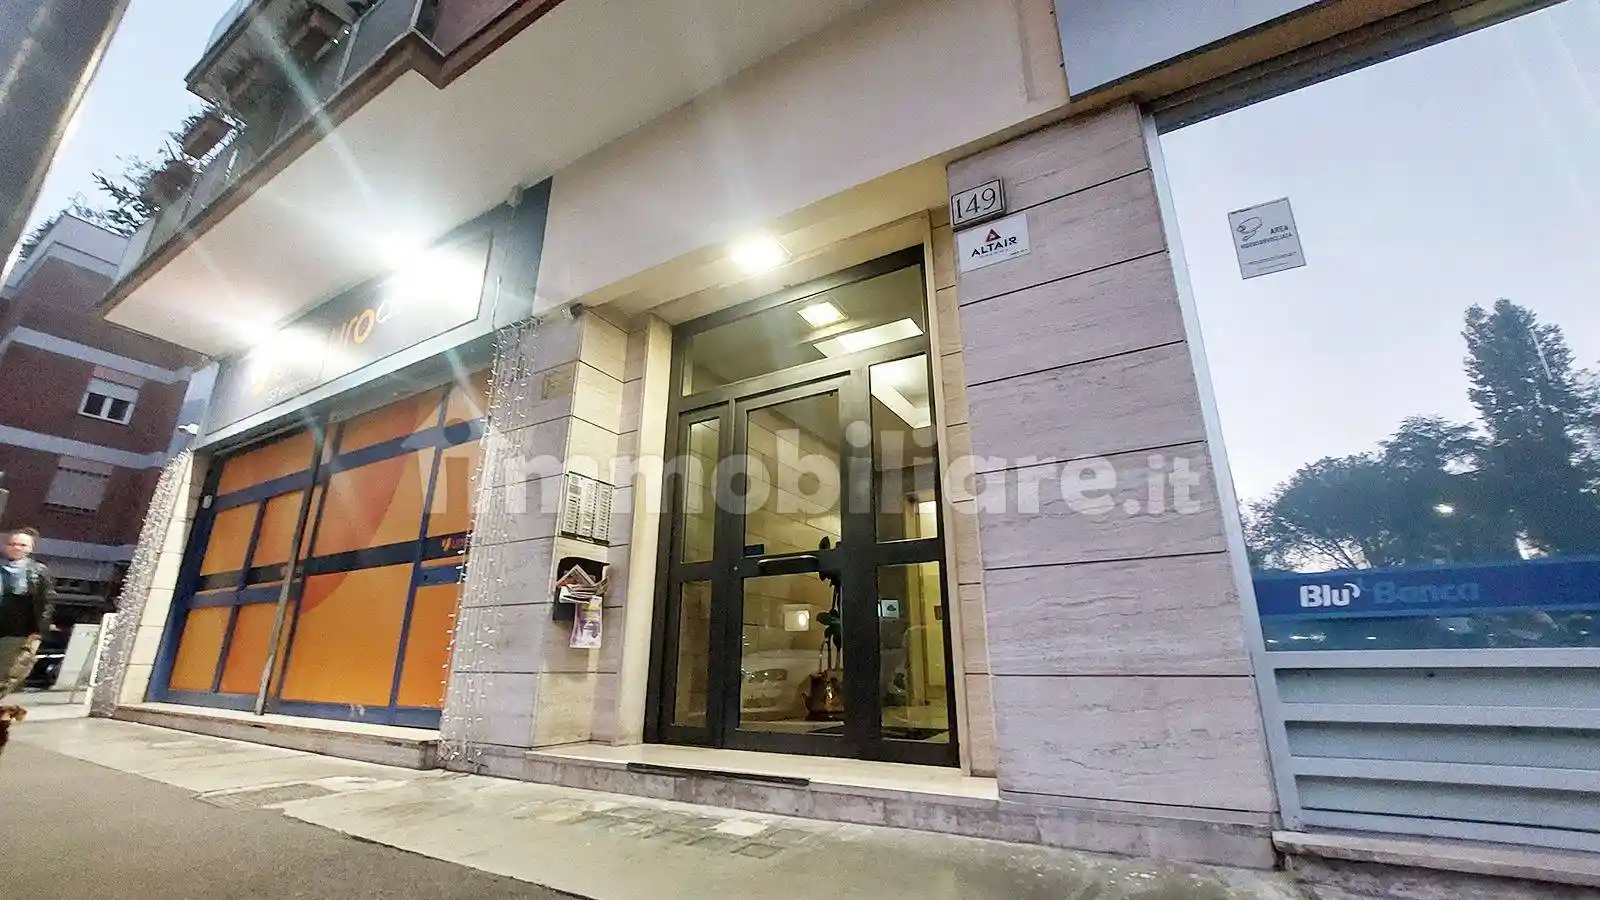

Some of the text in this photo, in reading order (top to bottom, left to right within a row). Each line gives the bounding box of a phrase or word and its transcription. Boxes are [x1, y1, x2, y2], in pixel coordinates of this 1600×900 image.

[956, 187, 996, 218] 149
[971, 236, 1018, 257] ALTAIR
[1300, 580, 1480, 608] Blu Banca
